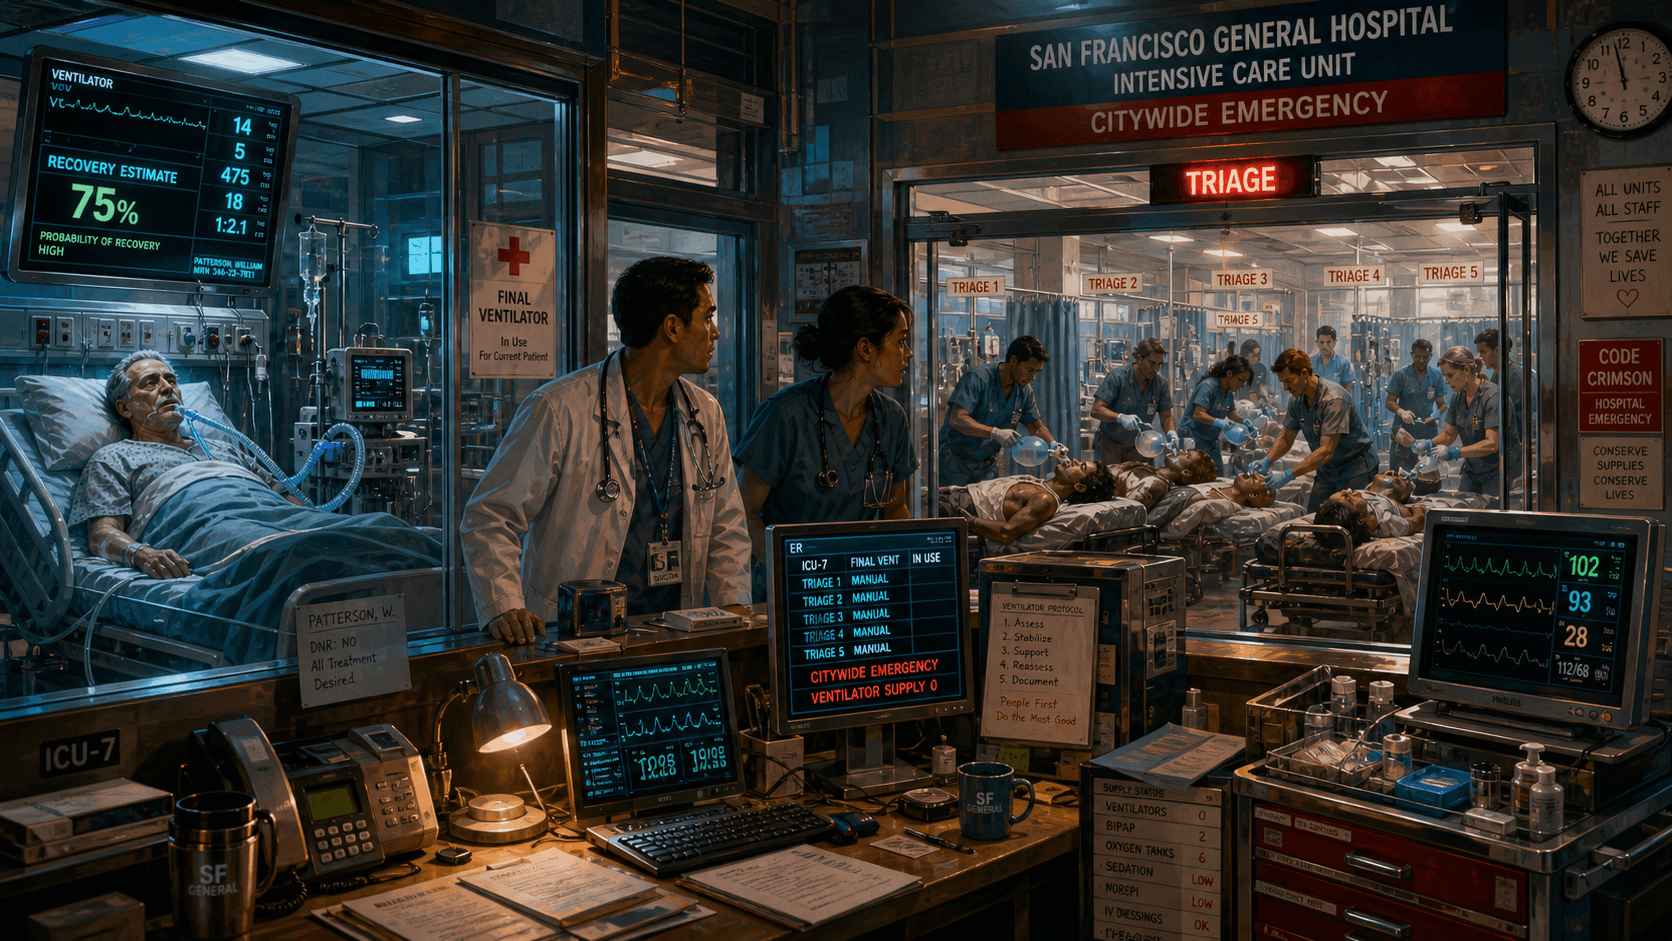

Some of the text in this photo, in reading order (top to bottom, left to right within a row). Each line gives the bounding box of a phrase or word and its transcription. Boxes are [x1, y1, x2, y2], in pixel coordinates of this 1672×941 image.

[1030, 4, 1454, 72] SAN FRANCISCO GENERAL HOSPITAL
[1618, 38, 1630, 49] 12
[1601, 41, 1645, 56] 11 1
[1587, 53, 1660, 70] 10 2
[52, 68, 114, 89] VENTILATOR
[1113, 51, 1356, 95] INTENSIVE CARE UNIT
[1582, 72, 1666, 89] 9 3
[1588, 91, 1660, 106] 8 4
[1091, 90, 1388, 134] CITYWIDE EMERGENCY
[1602, 105, 1647, 118] 7 5
[1620, 111, 1628, 123] 6
[233, 117, 252, 136] 14
[234, 143, 245, 160] 5
[48, 155, 178, 184] RECOVERY ESTIMATE
[220, 166, 250, 186] 475
[1186, 165, 1277, 196] TRIAGE
[1595, 180, 1661, 197] ALL UNITS
[71, 183, 139, 225] 75%
[225, 193, 243, 210] 18
[1595, 200, 1661, 216] ALL STAFF
[215, 217, 247, 236] 1:2.1
[40, 231, 160, 251] PROBABILITY OF RECOVERY
[1596, 228, 1661, 244] TOGETHER
[38, 245, 64, 257] HIGH
[1599, 248, 1657, 264] WE SAVE
[1217, 273, 1268, 286] TRIAGE 3
[1328, 269, 1380, 282] TRIAGE 4
[1424, 266, 1478, 280] TRIAGE 5
[1610, 268, 1646, 282] LIVES
[952, 281, 998, 294] TRIAGE 1
[1089, 277, 1137, 290] TRIAGE 2
[498, 290, 531, 305] FINAL
[479, 308, 548, 325] VENTILATOR
[501, 336, 527, 347] In Use
[479, 350, 548, 362] For Current Patient
[1599, 348, 1640, 364] CODE
[1588, 371, 1652, 386] CRIMSON
[1595, 398, 1645, 409] HOSPITAL
[1589, 413, 1652, 424] EMERGENCY
[1593, 446, 1648, 456] CONSERVE
[1597, 461, 1644, 470] SUPPLIES
[1593, 475, 1648, 485] CONSERVE
[1606, 490, 1634, 499] LIVES
[790, 543, 803, 554] ER
[802, 552, 940, 570] ICU-7 FINAL VENT IN USE
[1569, 555, 1599, 578] 102
[802, 574, 889, 589] TRIAGE 1 MANUAL
[803, 591, 889, 607] TRIAGE 2 MANUAL
[1569, 590, 1591, 613] 93
[1002, 602, 1084, 614] VENTILATOR PROTOCOL
[309, 605, 396, 628] PATTERSON, W.
[804, 608, 890, 625] TRIAGE 3 MANUAL
[1004, 619, 1044, 628] 1. Assess
[804, 626, 890, 642] TRIAGE 4 MANUAL
[1002, 633, 1052, 643] 2. Stabilize
[1564, 625, 1588, 648] 28
[310, 637, 356, 653] DNR: NO
[805, 643, 891, 660] TRIAGE 5 MANUAL
[1001, 647, 1049, 658] 3. Support
[311, 653, 377, 672] All Treatment
[1000, 661, 1053, 671] 4. Reassess
[1558, 661, 1589, 678] 112/68
[810, 659, 939, 684] CITYWIDE EMERGENCY
[314, 672, 355, 690] Desired
[999, 675, 1058, 686] 5. Document
[811, 686, 880, 704] VENTILATOR
[885, 681, 926, 696] SUPPLY
[1000, 696, 1058, 709] People First
[997, 711, 1076, 725] Do the Most Good
[46, 736, 116, 772] ICU-7
[1103, 783, 1132, 794] SUPPLY
[976, 792, 994, 805] SF
[967, 804, 1003, 814] GENERAL
[1105, 801, 1167, 817] VENTILATORS
[1106, 820, 1206, 842] BIPAP 2
[1106, 841, 1206, 863] OXYGEN TANKS 6
[199, 864, 228, 884] SF
[1106, 861, 1214, 886] SEDATION LOW
[188, 882, 238, 897] GENERAL
[1105, 883, 1213, 909] NOREPI LOW
[1105, 906, 1113, 916] IV
[1194, 920, 1210, 931] OK
